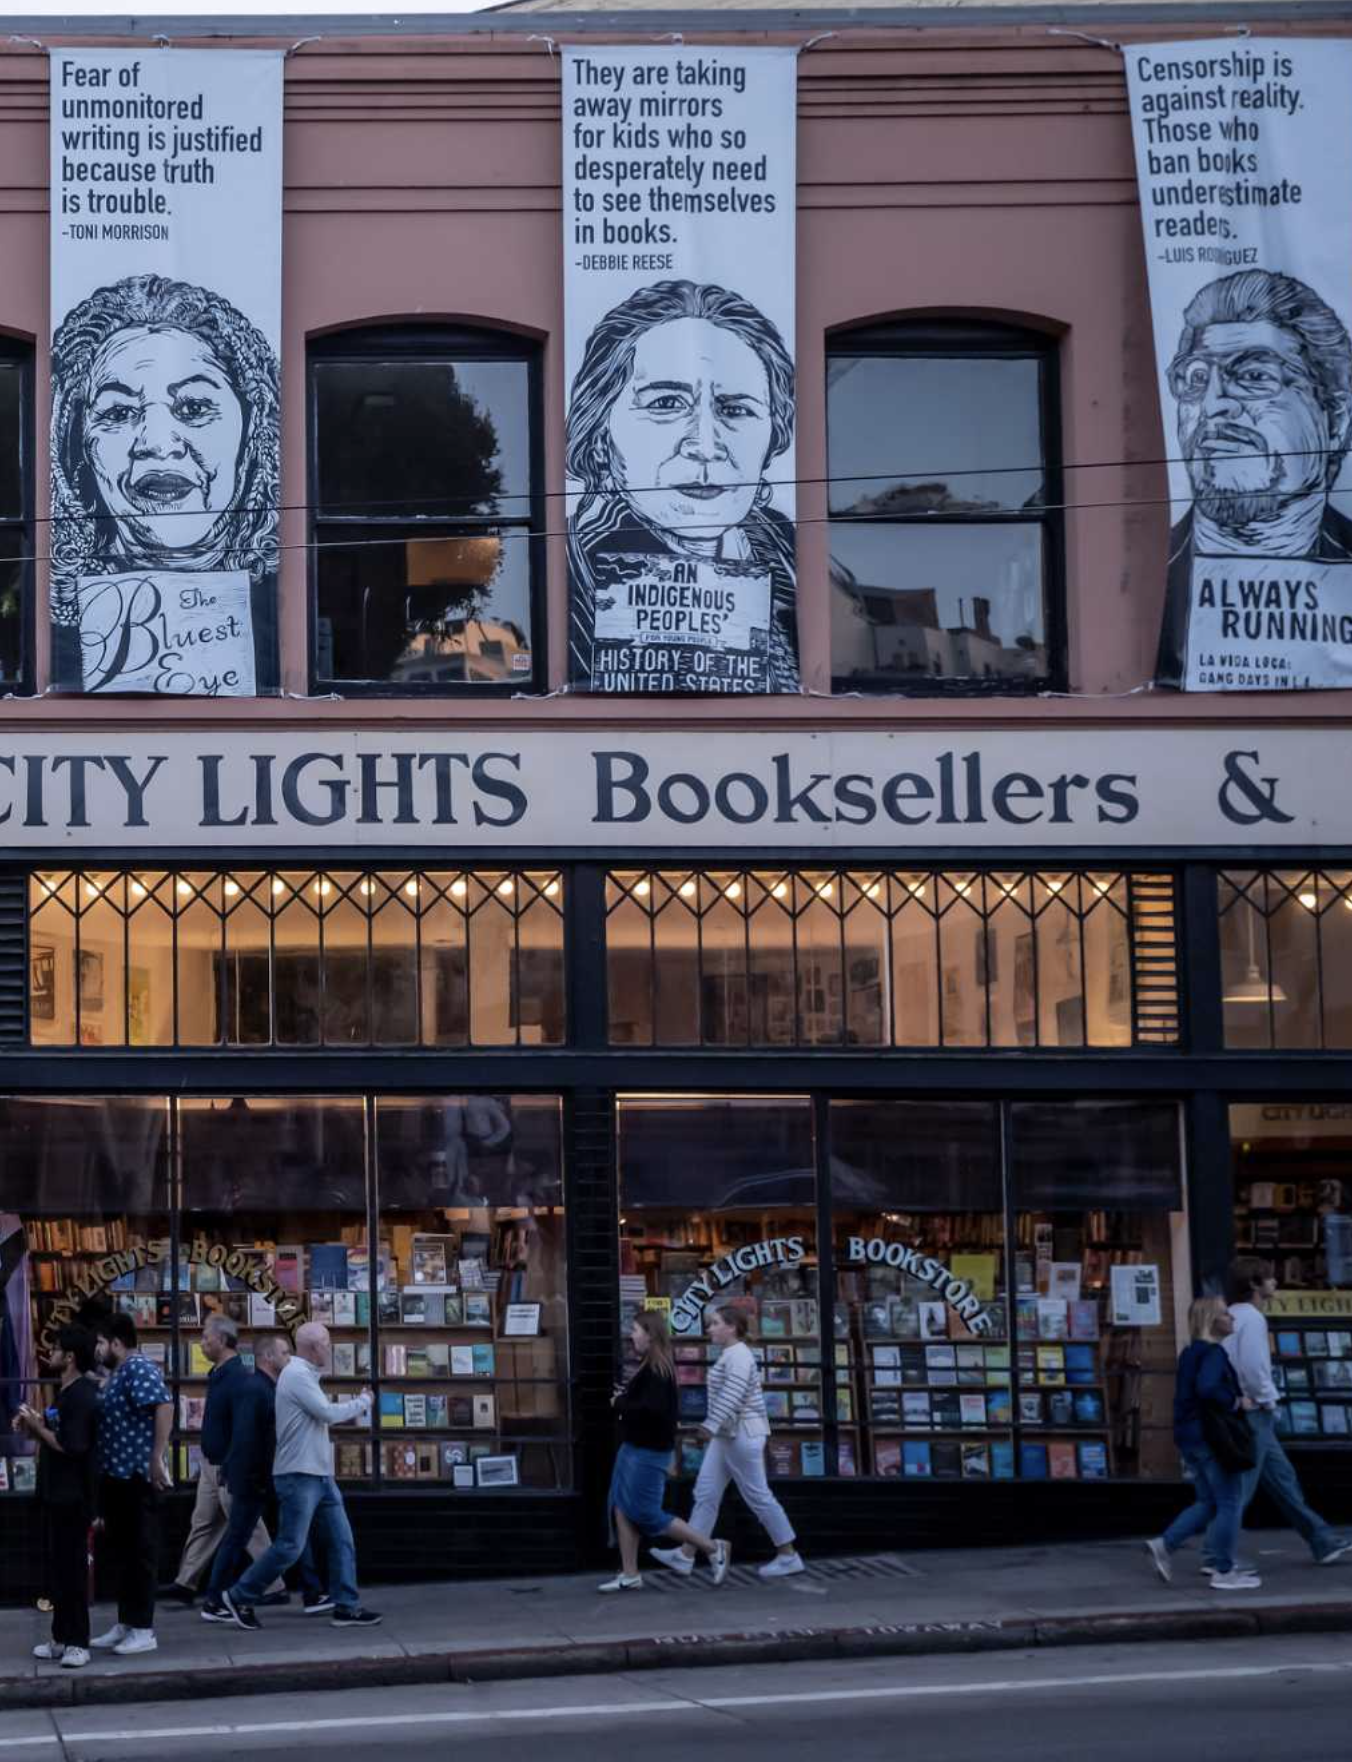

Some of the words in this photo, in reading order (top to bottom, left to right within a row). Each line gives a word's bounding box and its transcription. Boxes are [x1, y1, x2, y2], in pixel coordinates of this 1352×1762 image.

[62, 61, 112, 87] Fear
[118, 62, 141, 87] of
[572, 58, 625, 92] They
[632, 64, 668, 85] are
[676, 59, 746, 93] taking
[1137, 50, 1265, 83] Censorship
[1273, 51, 1292, 77] is
[62, 93, 203, 120] unmonitored
[573, 97, 631, 123] away
[639, 91, 723, 117] mirrors
[1141, 85, 1226, 118] against
[1231, 82, 1304, 116] reality.
[62, 124, 139, 157] writing
[148, 125, 166, 150] is
[171, 125, 263, 158] justified
[573, 122, 605, 149] for
[613, 122, 660, 149] kids
[668, 123, 712, 149] who
[720, 129, 746, 149] so
[1142, 117, 1212, 144] Those
[1219, 116, 1259, 142] who
[62, 156, 156, 181] because
[164, 157, 214, 184] truth
[574, 154, 705, 188] desperately
[712, 154, 767, 181] need
[1148, 149, 1190, 175] ban
[1198, 147, 1258, 173] books
[62, 187, 80, 213] is
[87, 187, 172, 215] trouble.
[573, 187, 594, 212] to
[602, 192, 641, 212] see
[648, 185, 776, 213] themselves
[1152, 179, 1302, 207] underestimate
[102, 224, 169, 240] MORRISON
[575, 217, 594, 244] in
[603, 217, 678, 244] books.
[633, 253, 673, 270] REESE
[1198, 246, 1258, 266] ROGUEZ
[673, 563, 698, 584] AN
[179, 588, 217, 609] The
[628, 585, 735, 612] INDIGENOUS
[1199, 578, 1318, 610] ALWAYS
[78, 576, 241, 692] Bluest
[636, 610, 729, 634] PEOPLES'
[1222, 609, 1352, 645] RUNNING
[153, 652, 239, 696] Eye
[600, 648, 681, 672] HISTORY
[694, 651, 715, 672] OF
[725, 655, 760, 677] THE
[1199, 653, 1215, 667] LA
[1219, 654, 1249, 668] VIDA
[604, 672, 673, 692] UNITED
[687, 673, 755, 693] STATES
[1199, 672, 1233, 685] GANG
[1238, 673, 1269, 686] DAYS
[196, 752, 528, 827] LIGHTS
[590, 750, 1140, 826] Booksellers
[1217, 750, 1296, 825] &
[670, 1271, 716, 1334] CITY
[711, 1236, 805, 1288] LIGHTS
[848, 1236, 993, 1336] BOOKSTORE
